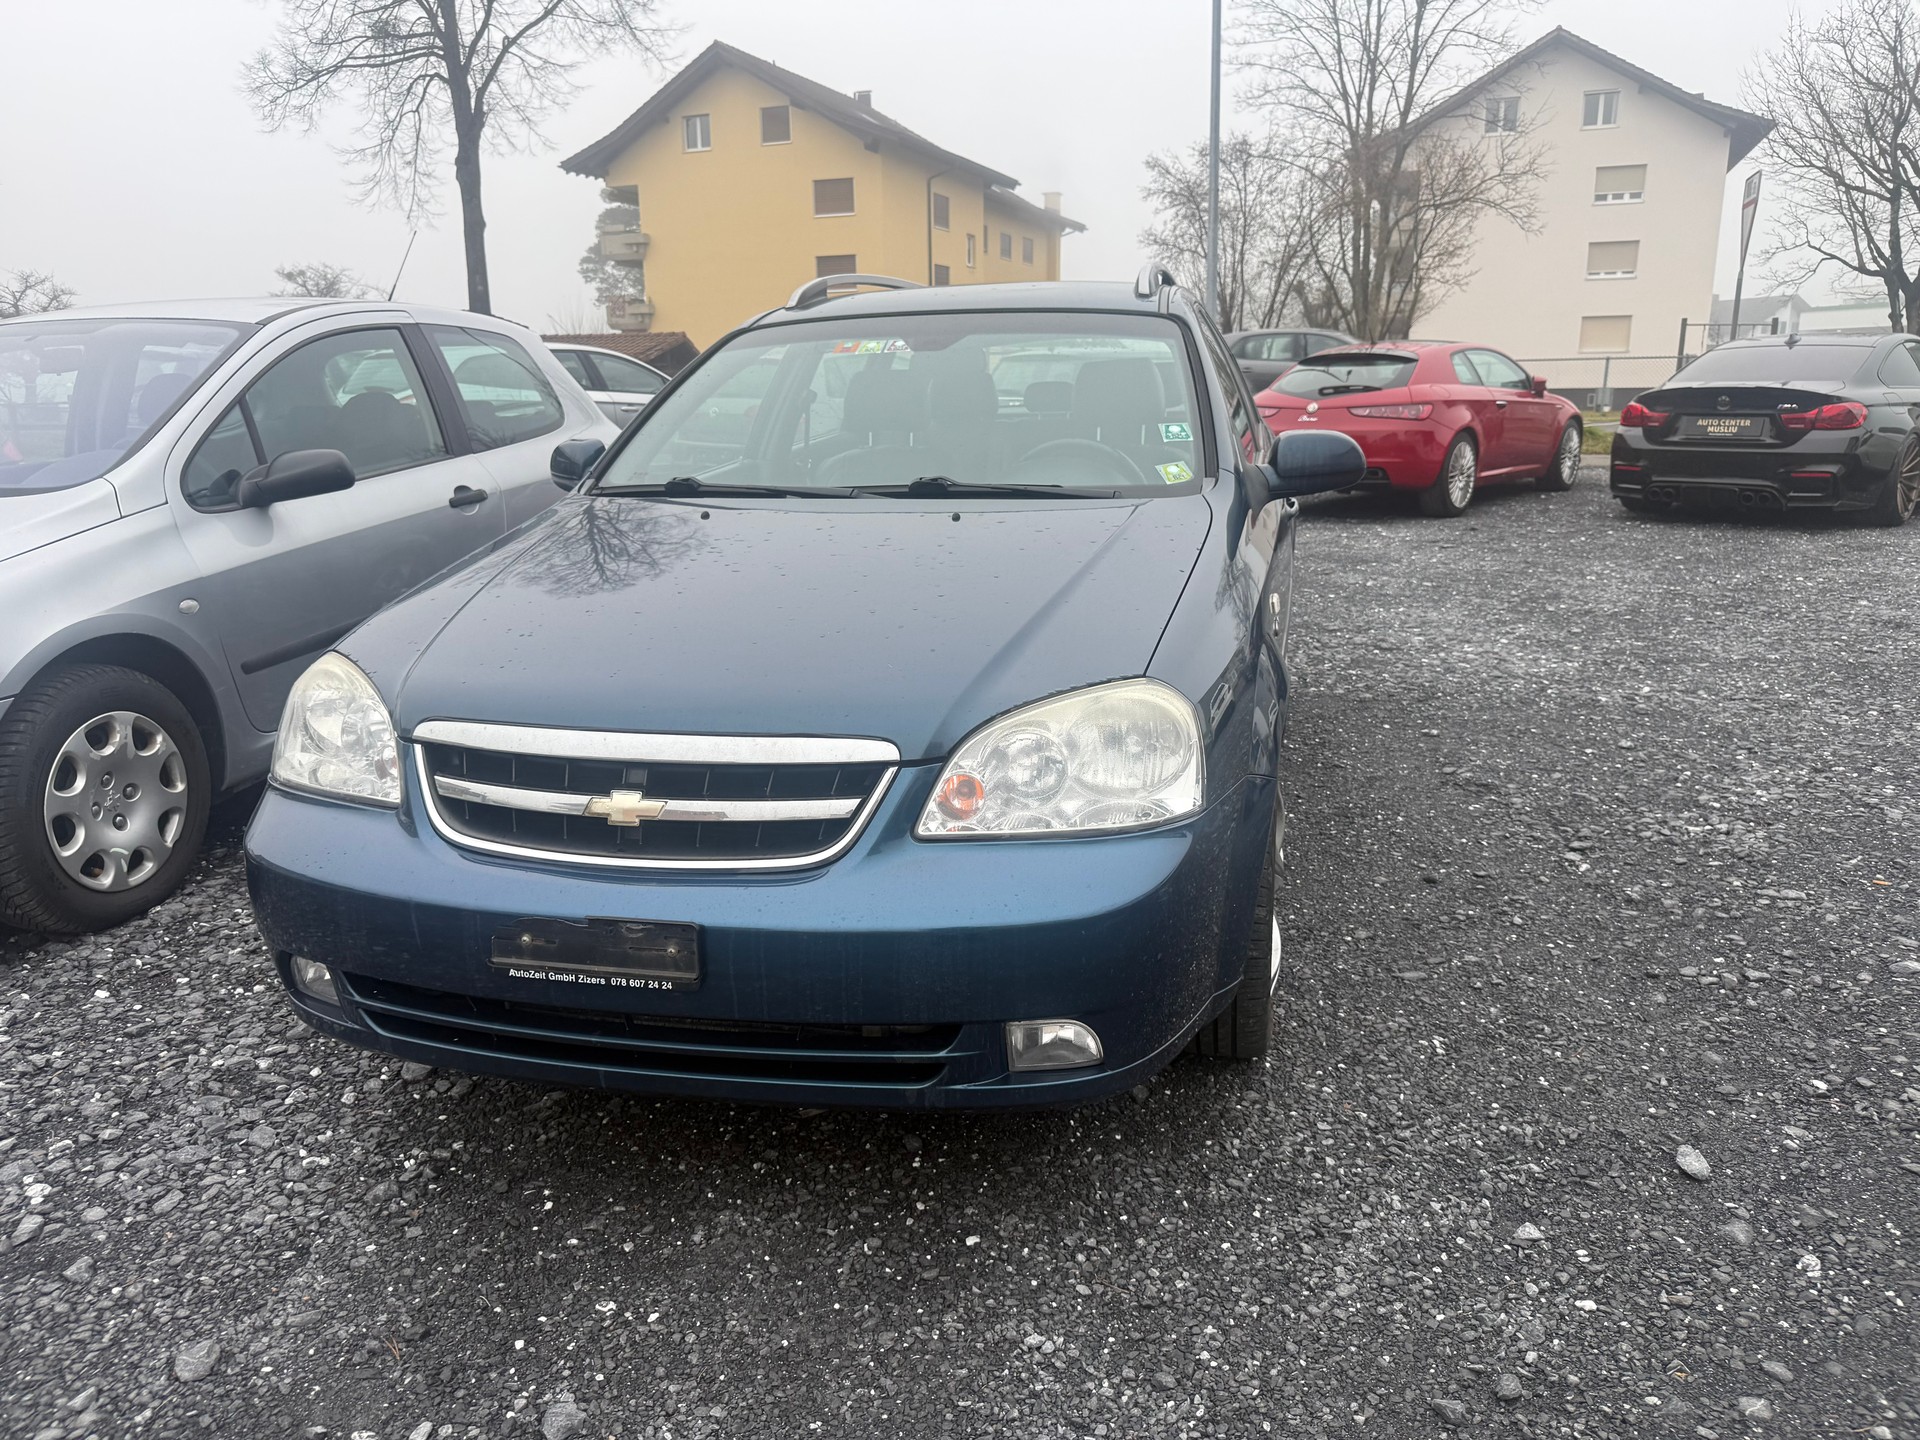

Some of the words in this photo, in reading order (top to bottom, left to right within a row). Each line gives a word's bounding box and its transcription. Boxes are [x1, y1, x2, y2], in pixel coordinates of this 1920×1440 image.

[1696, 418, 1719, 426] AUTO
[1719, 418, 1751, 427] CENTER
[1707, 425, 1738, 433] MUSLIU
[508, 968, 546, 980] AutoZeit
[548, 971, 576, 982] GmbH
[577, 974, 606, 985] Zizers
[610, 977, 627, 987] 078
[629, 979, 646, 988] 607
[647, 980, 659, 989] 24
[661, 981, 673, 990] 24
